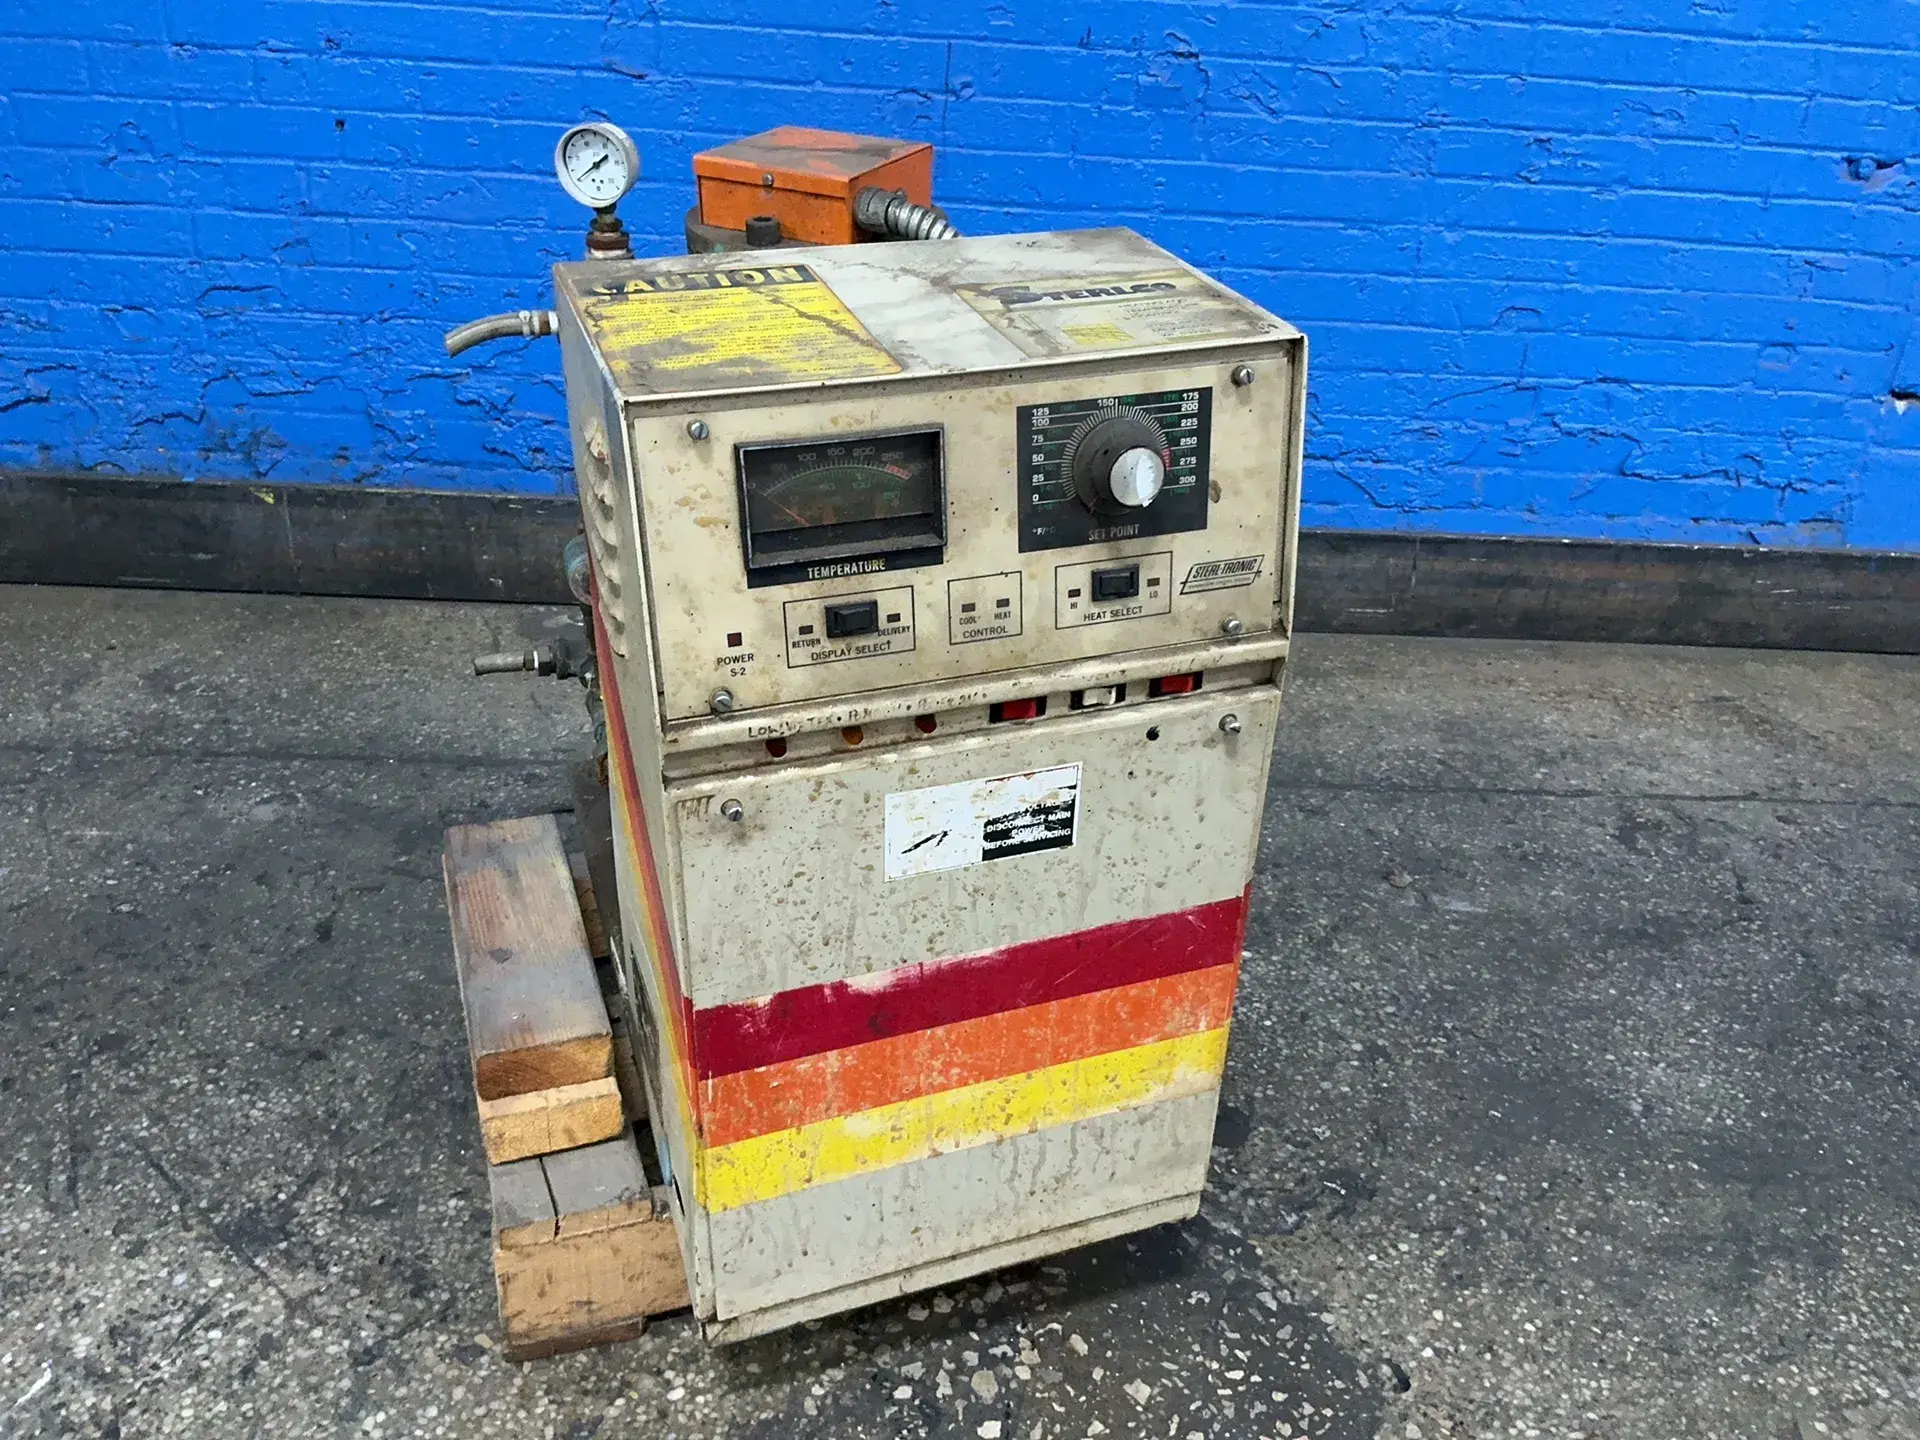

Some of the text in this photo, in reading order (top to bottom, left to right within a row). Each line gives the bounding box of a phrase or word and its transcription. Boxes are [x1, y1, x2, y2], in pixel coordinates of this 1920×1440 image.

[592, 266, 804, 295] CAUTION
[990, 281, 1176, 304] STERLCO
[1182, 391, 1199, 401] 175
[1097, 398, 1114, 407] 150
[1181, 402, 1199, 411] 200
[1032, 407, 1049, 416] 125
[1032, 418, 1049, 427] 100
[1180, 418, 1198, 427] 225
[1032, 434, 1044, 443] 75
[1179, 436, 1197, 446] 250
[852, 446, 875, 457] 200
[797, 452, 817, 462] 100
[1032, 453, 1044, 462] 50
[1179, 456, 1197, 466] 275
[1032, 473, 1044, 482] 25
[1179, 475, 1196, 484] 300
[1032, 493, 1039, 501] 0
[1088, 524, 1140, 541] SET POINT
[807, 559, 886, 580] TEMPERATURE
[1149, 590, 1158, 599] LO
[1070, 602, 1078, 610] HI
[994, 610, 1011, 621] HEAT
[1083, 605, 1143, 622] HEAT SELECT
[959, 615, 977, 625] COOL
[877, 625, 911, 637] DELIVERY
[963, 625, 1008, 639] CONTROL
[791, 638, 821, 649] RETURN
[811, 640, 891, 661] DISPLAY SELECT
[716, 653, 754, 666] POWER
[730, 667, 746, 677] S-2
[1048, 811, 1071, 821] MAIN
